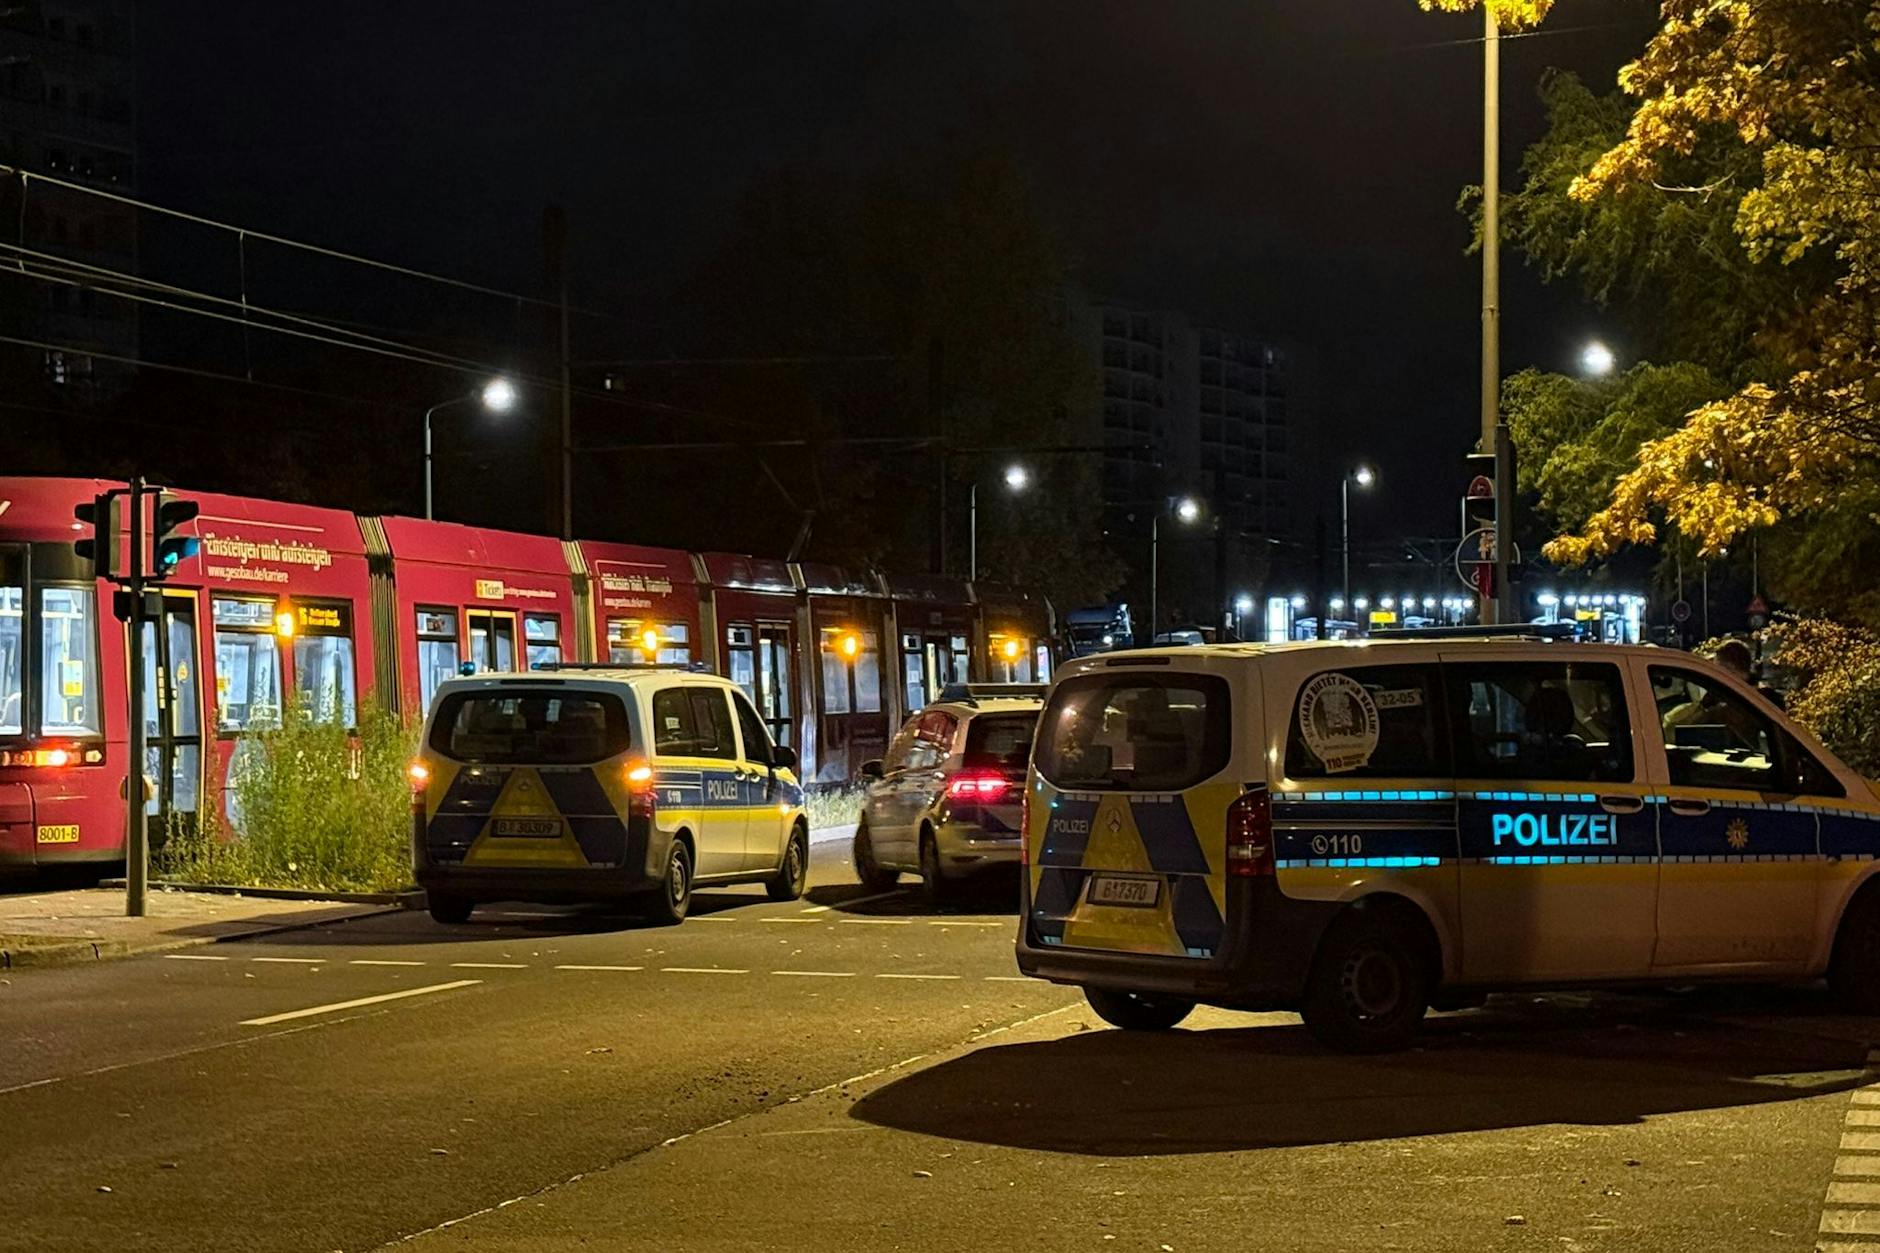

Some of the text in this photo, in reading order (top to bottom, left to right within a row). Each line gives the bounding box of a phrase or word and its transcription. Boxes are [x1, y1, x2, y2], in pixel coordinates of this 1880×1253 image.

[259, 539, 281, 561] und
[1380, 692, 1415, 706] 32-05
[708, 780, 738, 800] POLIZEI
[39, 826, 78, 841] 8001-B
[1053, 819, 1089, 834] POLIZEI
[1491, 812, 1618, 847] POLIZEI
[1329, 834, 1362, 854] 110
